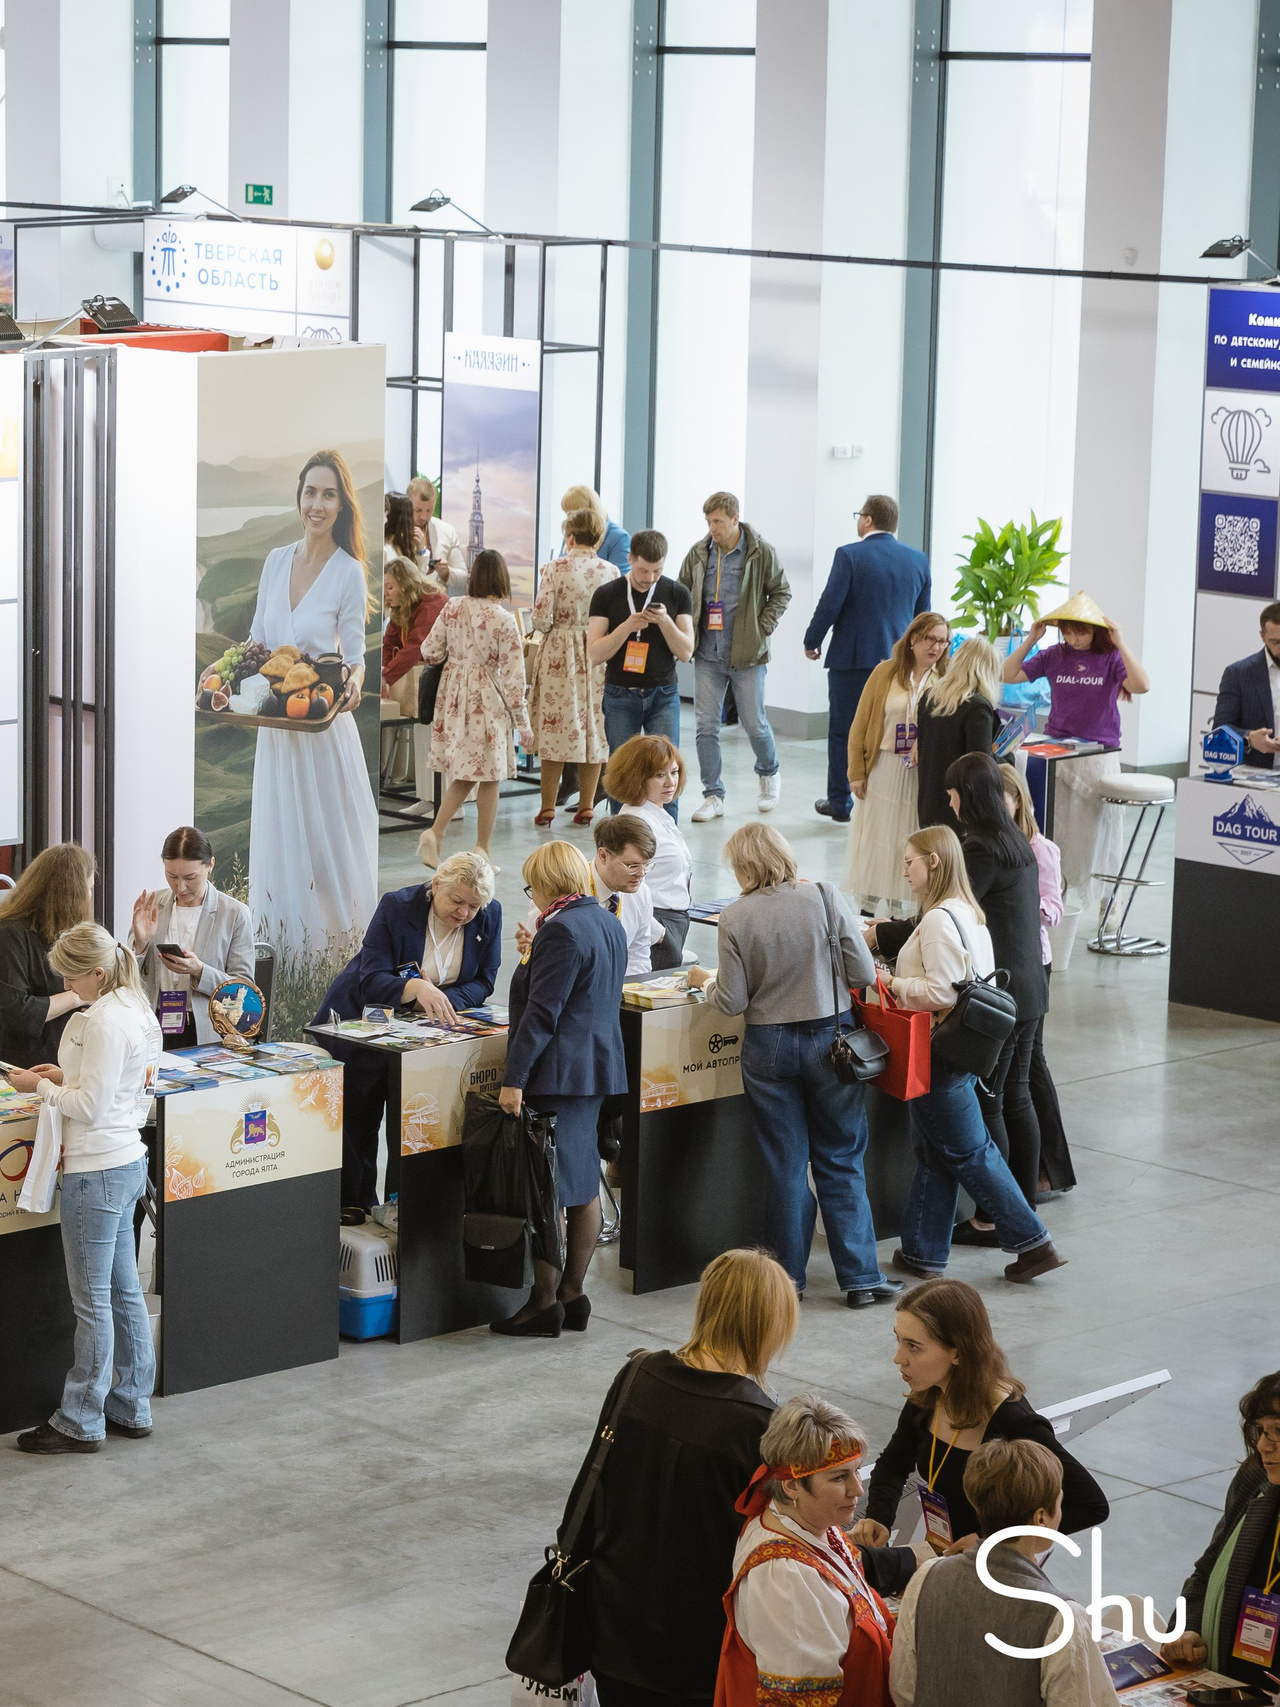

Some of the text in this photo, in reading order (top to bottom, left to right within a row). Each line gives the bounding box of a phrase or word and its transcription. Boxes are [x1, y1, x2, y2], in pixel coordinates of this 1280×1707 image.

[194, 241, 283, 266] ТВЕРСКАЯ
[198, 267, 280, 291] ОБЛАСТЬ
[1214, 334, 1228, 345] ПО
[1230, 357, 1238, 367] И
[1204, 750, 1236, 762] DAG TOUR
[1215, 820, 1278, 842] DAG TOUR
[683, 1055, 740, 1074] МОЙ АВТОПР
[470, 1067, 497, 1085] БЮРО
[225, 1150, 286, 1169] АДМИНИСТРАЦИЯ
[232, 1164, 278, 1179] ГОРОДА ЯЛТА
